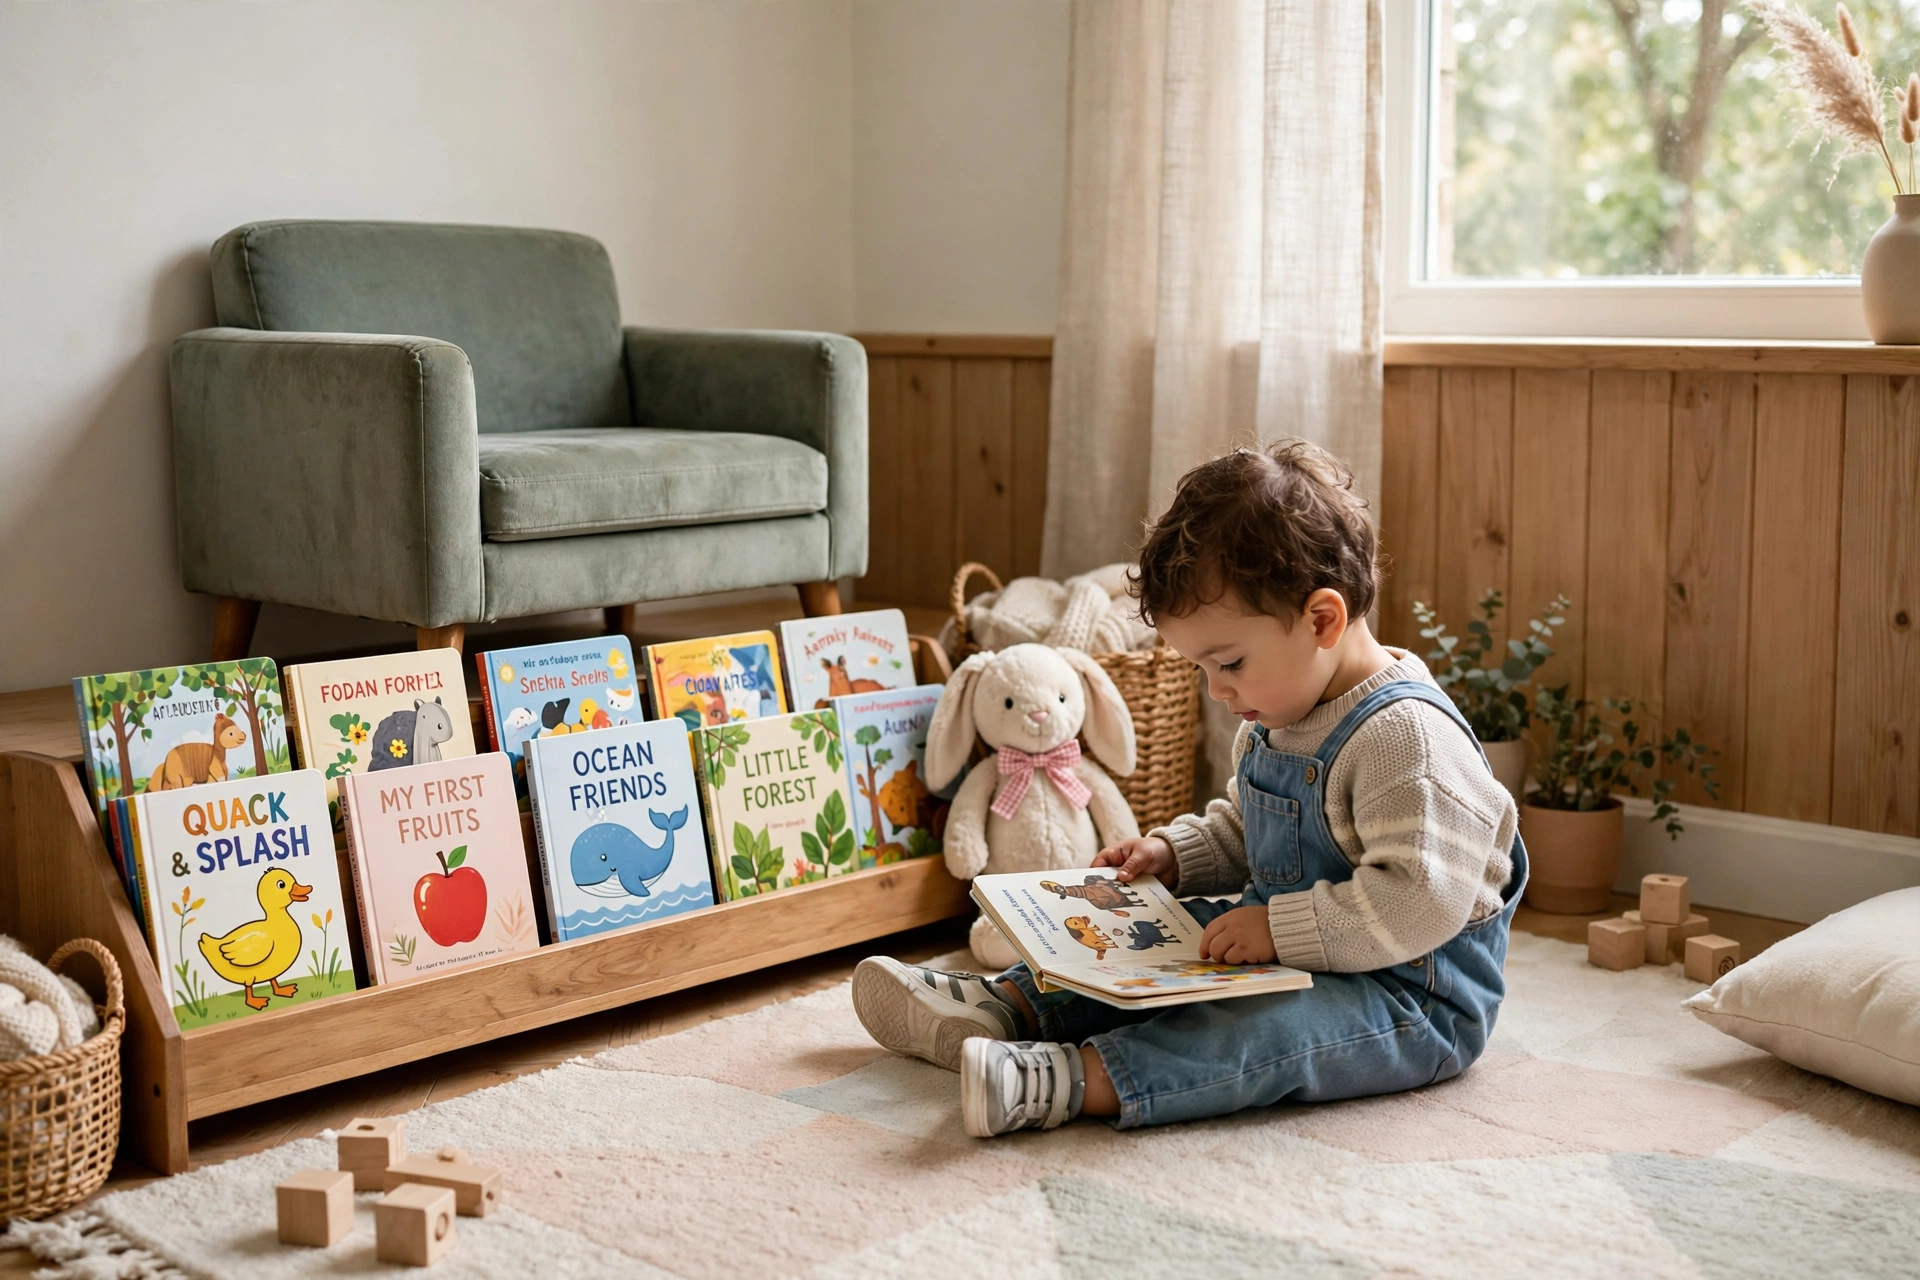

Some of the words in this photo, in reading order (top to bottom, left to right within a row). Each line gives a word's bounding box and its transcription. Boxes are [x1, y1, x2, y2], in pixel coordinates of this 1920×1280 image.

[320, 679, 378, 703] FODAN
[572, 740, 654, 777] OCEAN
[743, 745, 809, 778] LITTLE
[380, 785, 414, 814] MY
[423, 774, 485, 807] FIRST
[569, 771, 667, 811] FRIENDS
[743, 776, 816, 812] FOREST
[182, 791, 290, 837] QUACK
[398, 807, 480, 844] FRUITS
[172, 851, 191, 877] &
[196, 824, 310, 874] SPLASH
